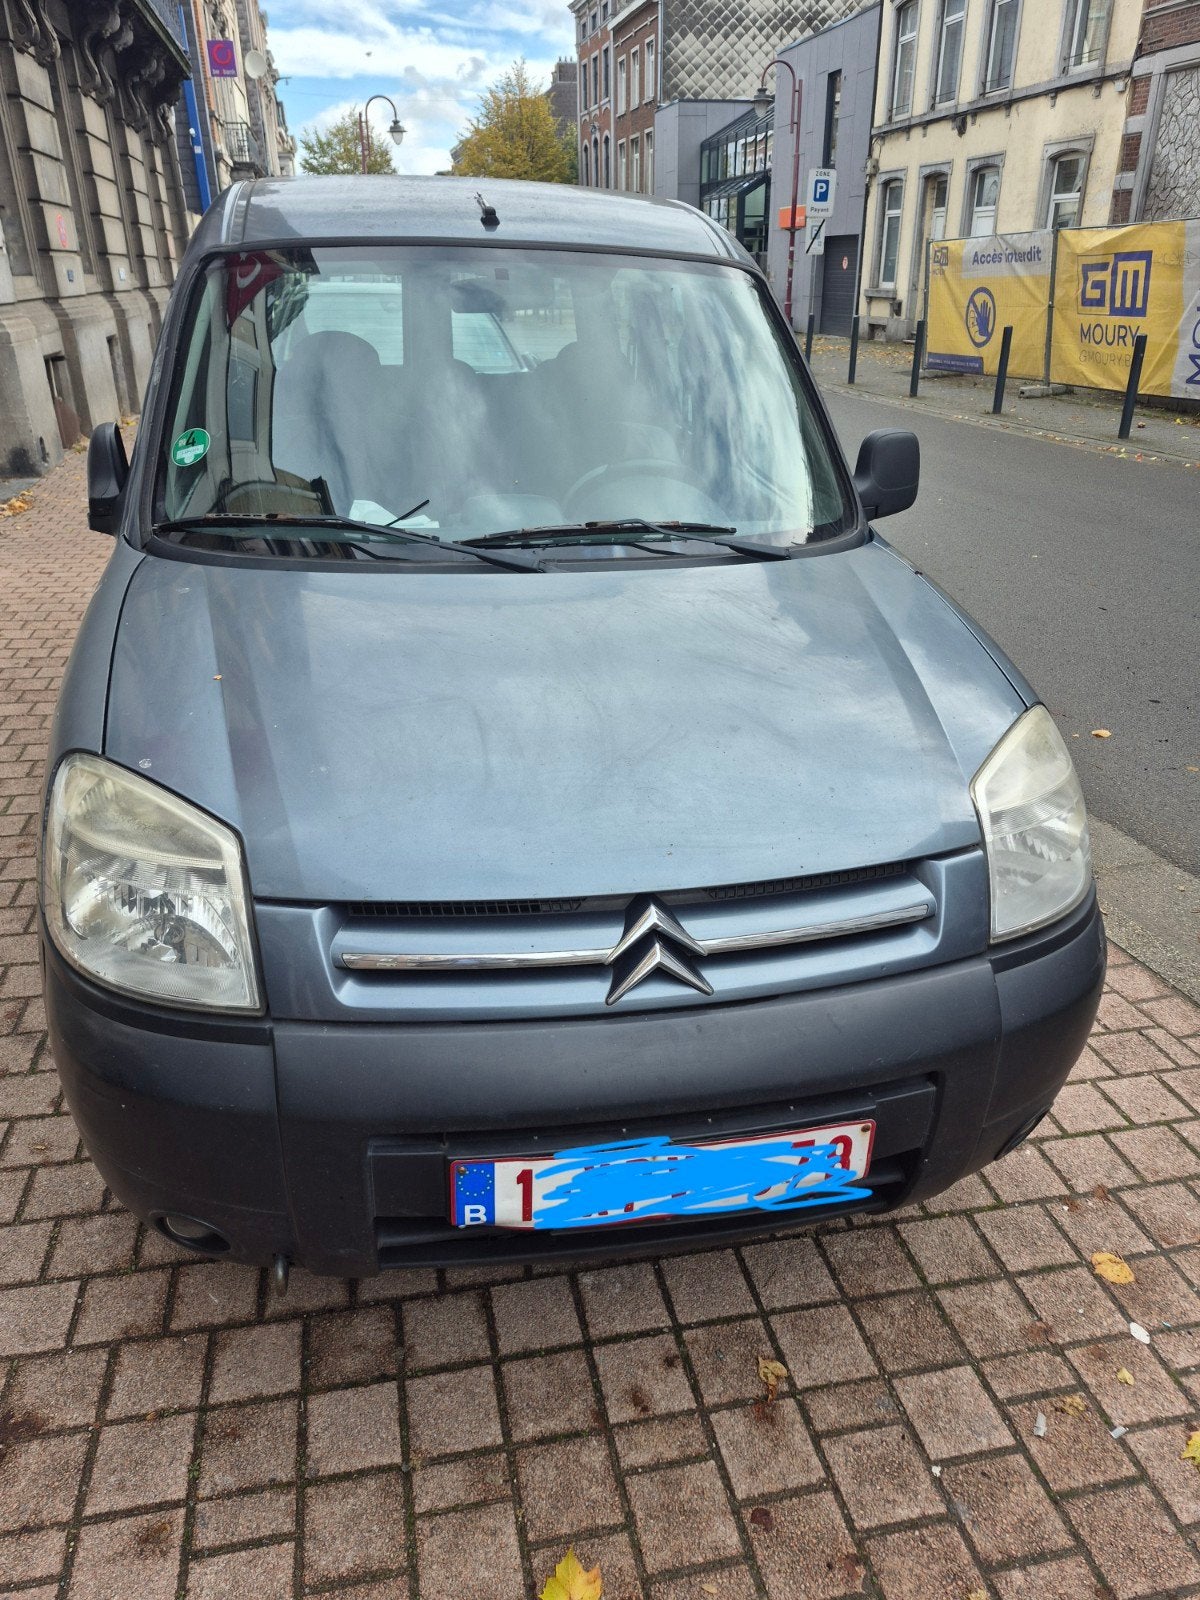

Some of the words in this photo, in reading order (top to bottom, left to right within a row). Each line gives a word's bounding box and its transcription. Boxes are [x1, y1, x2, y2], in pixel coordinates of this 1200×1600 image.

[815, 182, 827, 199] P
[972, 248, 1003, 266] Accès
[1004, 245, 1042, 264] interdit
[1080, 323, 1140, 347] MOURY
[1079, 349, 1132, 368] GMOURY.B
[186, 431, 196, 446] 4
[464, 1204, 487, 1226] B
